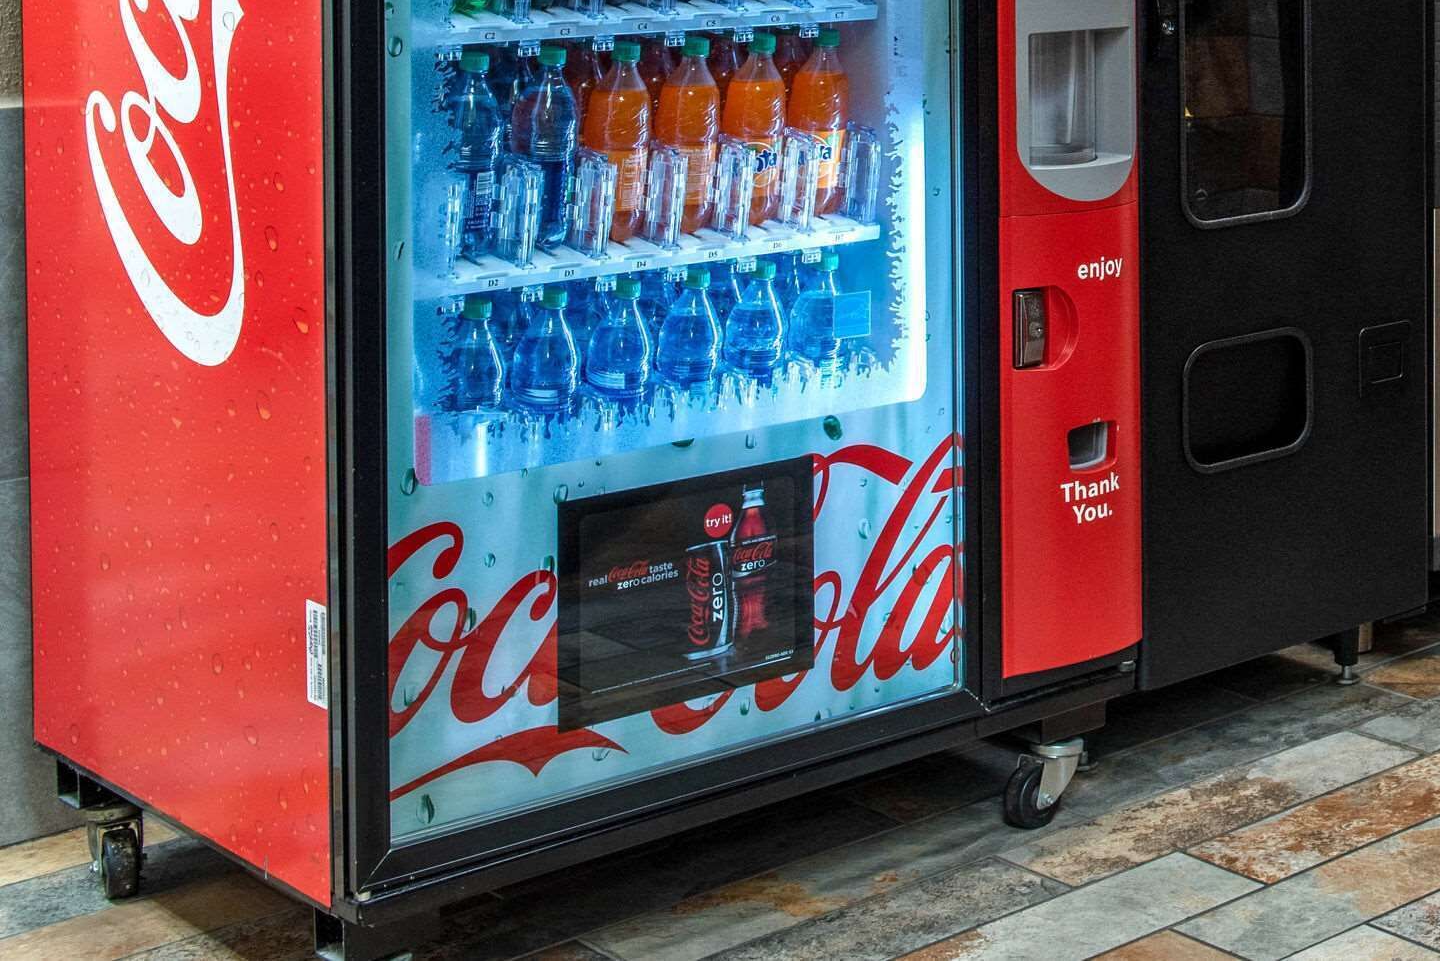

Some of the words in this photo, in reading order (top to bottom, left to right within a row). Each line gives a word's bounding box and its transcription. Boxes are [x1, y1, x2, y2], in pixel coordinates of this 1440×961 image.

[706, 19, 717, 27] C5
[770, 14, 781, 22] C6
[560, 27, 571, 35] C3
[638, 22, 648, 30] C4
[484, 32, 495, 40] C2
[636, 260, 647, 268] D4
[1077, 257, 1122, 280] enjoy
[564, 269, 575, 277] D3
[488, 279, 499, 287] D2
[1060, 471, 1120, 503] Thank
[705, 516, 721, 528] try
[721, 513, 732, 525] it!
[1072, 503, 1112, 525] You.
[732, 541, 773, 564] Coca-Cola
[740, 559, 766, 572] zero
[588, 574, 608, 588] real
[608, 559, 650, 583] Coca-Cola
[649, 562, 673, 574] taste
[617, 577, 640, 590] zero
[640, 569, 679, 585] calories
[687, 557, 712, 646] Coca-Cola
[713, 572, 723, 623] zero
